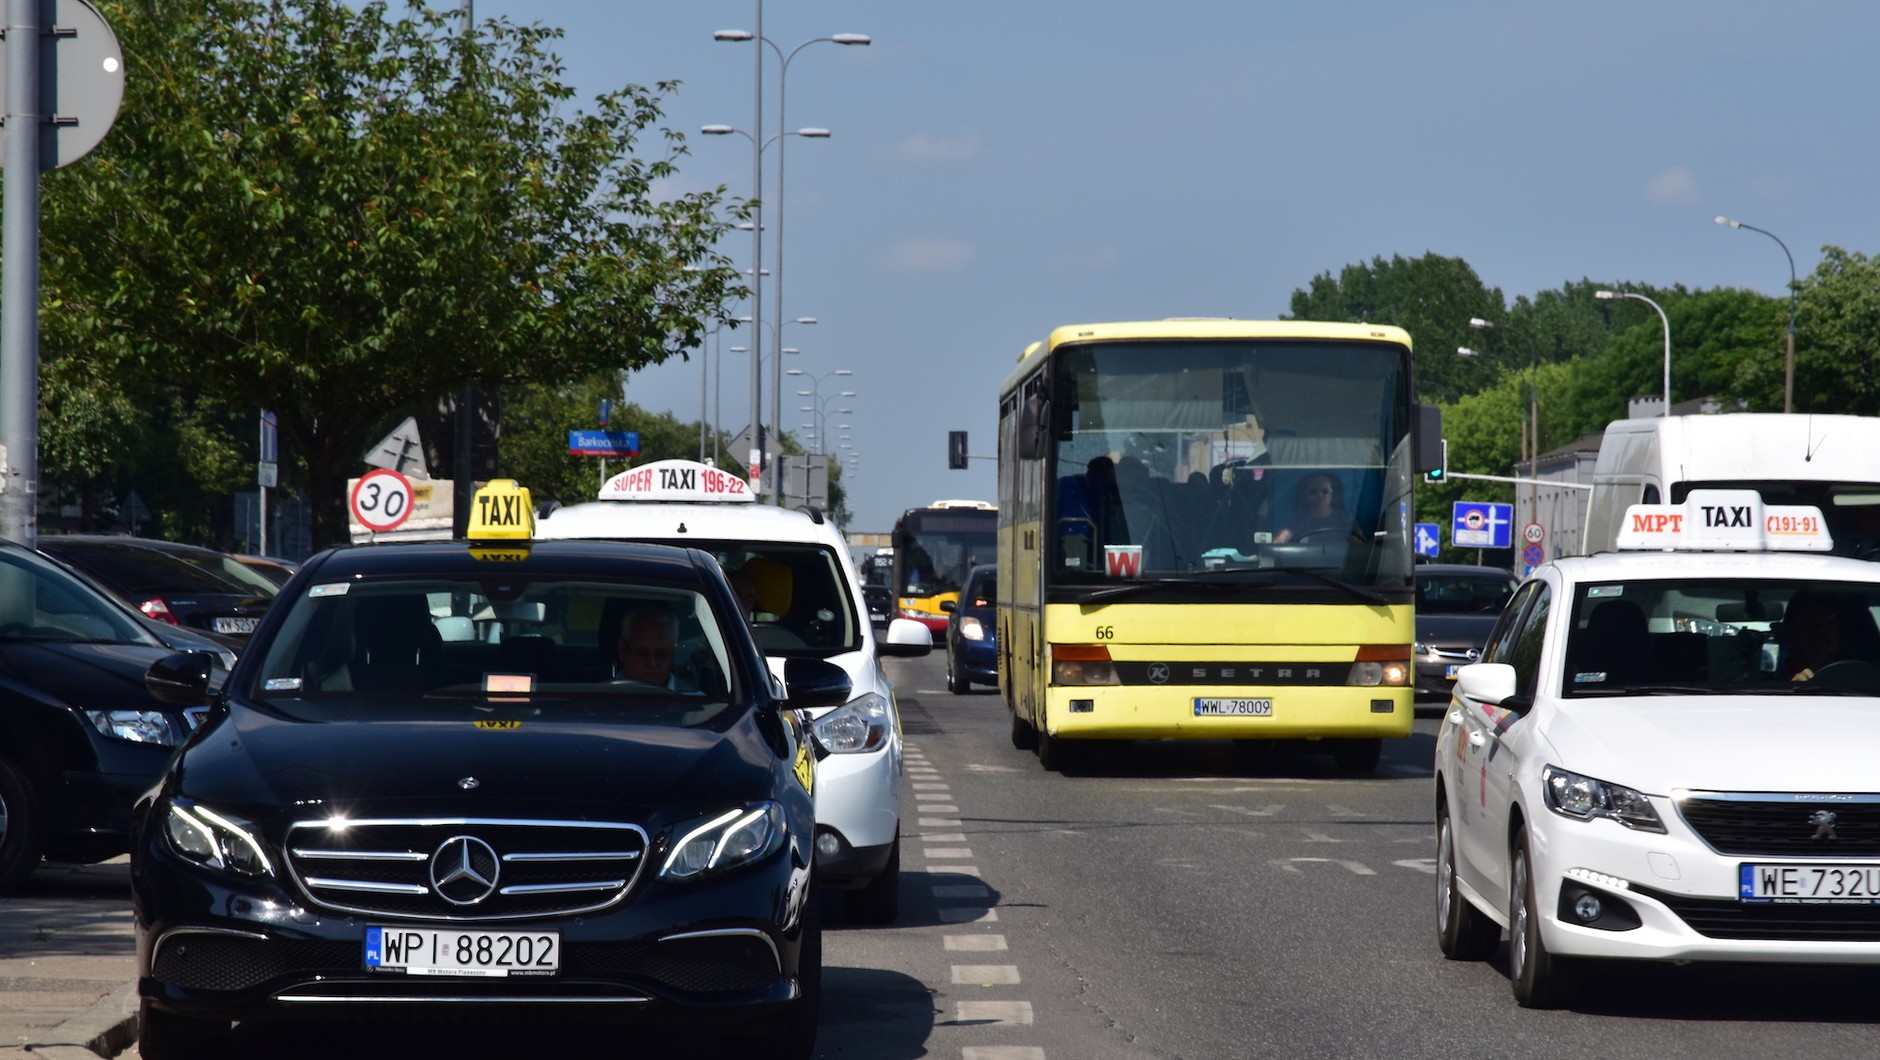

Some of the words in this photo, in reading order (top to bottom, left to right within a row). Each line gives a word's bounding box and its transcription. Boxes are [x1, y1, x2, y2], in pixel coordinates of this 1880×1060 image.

[614, 469, 652, 492] SUPER
[659, 469, 696, 490] TAXI
[701, 469, 745, 494] 196-22
[360, 483, 405, 517] 30
[478, 495, 521, 526] TAXI
[1632, 514, 1683, 533] MPT
[1701, 506, 1752, 528] TAXI
[1775, 516, 1819, 532] 191-91
[1527, 528, 1541, 539] 60
[1107, 551, 1141, 578] W
[1095, 625, 1114, 640] 66
[1192, 668, 1321, 678] SETRA
[1201, 700, 1226, 714] WWL
[1231, 700, 1270, 714] 78009
[1742, 884, 1752, 893] PL
[1761, 868, 1799, 895] WE
[1811, 869, 1880, 896] 732U
[367, 951, 379, 961] PL
[384, 932, 438, 965] WPI
[456, 934, 554, 966] 88202
